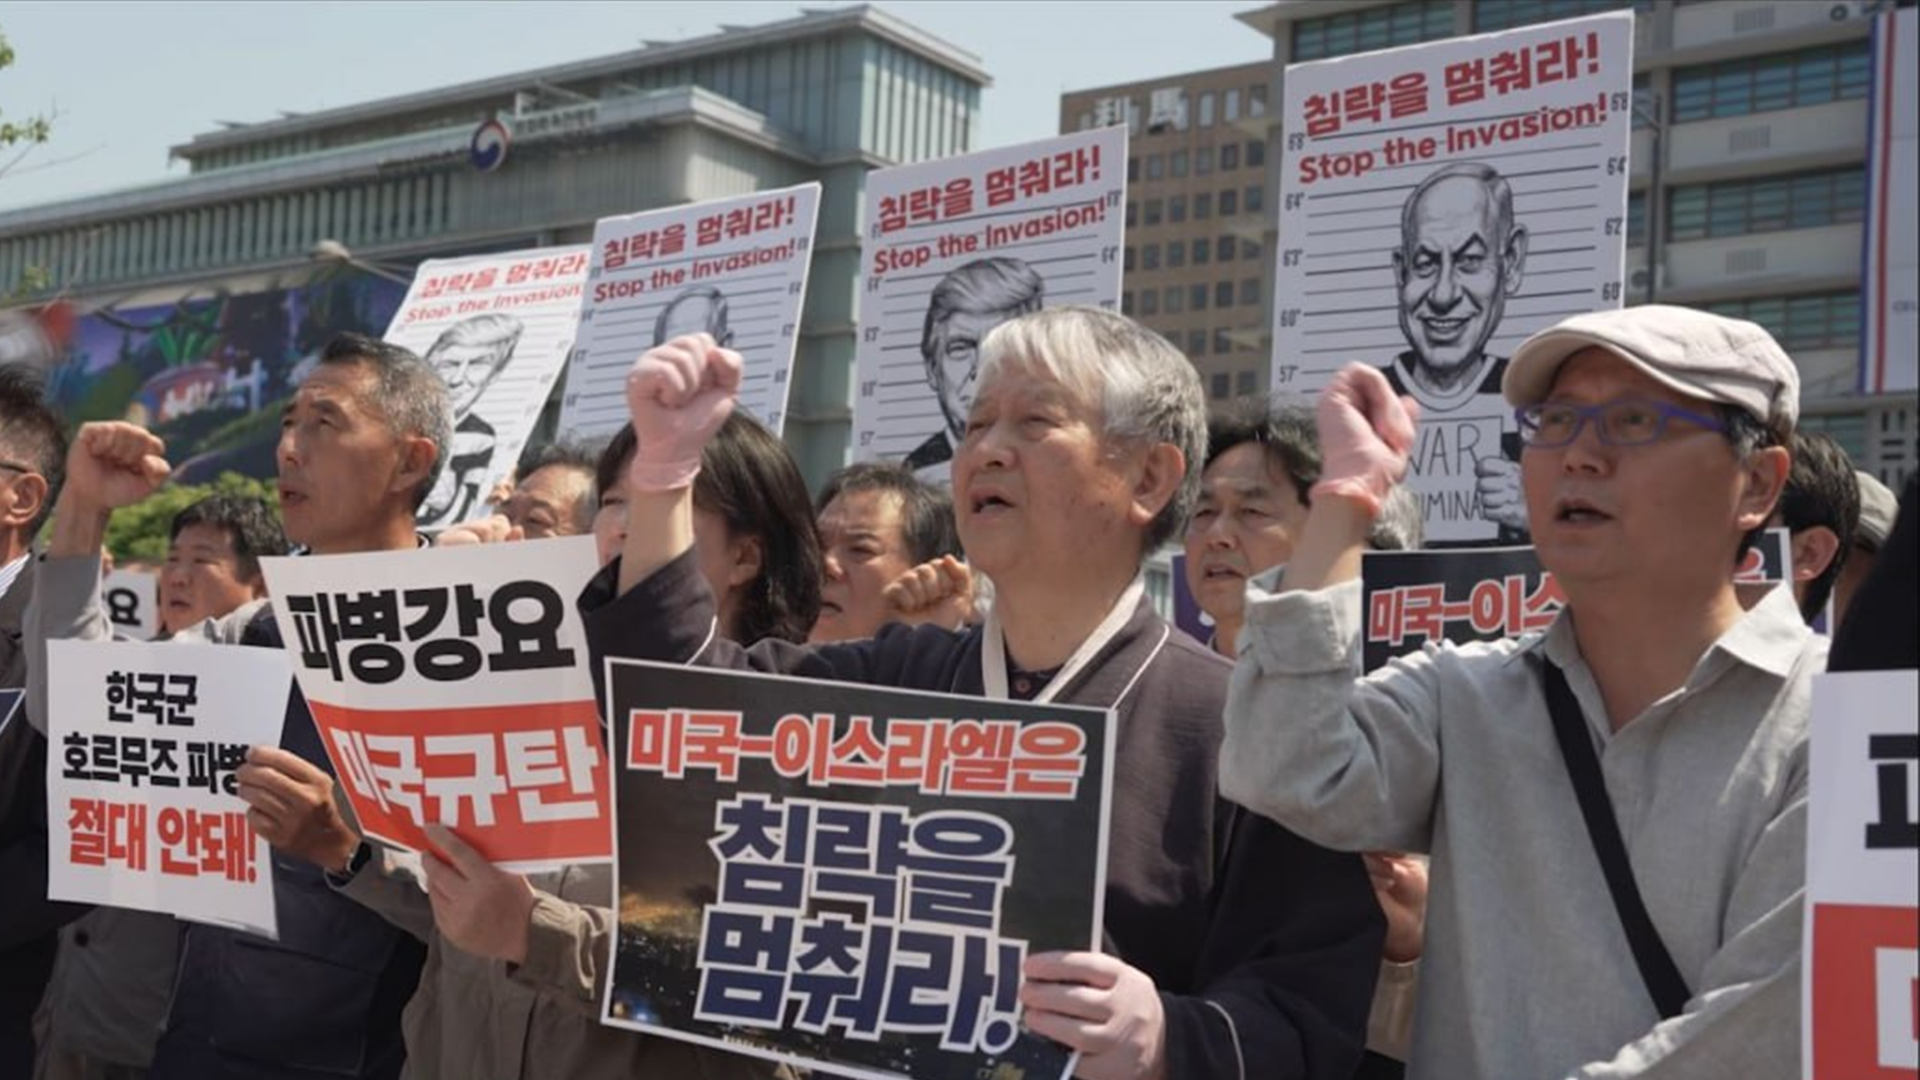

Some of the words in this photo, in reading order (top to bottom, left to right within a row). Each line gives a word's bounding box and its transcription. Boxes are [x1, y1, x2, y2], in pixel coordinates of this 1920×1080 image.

[1303, 73, 1429, 138] 침략을
[1444, 32, 1600, 105] 멈춰라!
[1299, 151, 1374, 184] Stop
[1383, 137, 1436, 166] the
[1446, 93, 1608, 153] Invasion!
[879, 178, 974, 232] 침략을
[985, 145, 1101, 207] 멈춰라!
[593, 277, 645, 303] Stop
[651, 264, 685, 288] the
[691, 238, 796, 279] Invasion!
[603, 223, 686, 271] 침략을
[696, 196, 796, 247] 멈춰라!
[874, 246, 931, 274] Stop
[938, 229, 978, 258] the
[985, 197, 1106, 249] Invasion!
[404, 306, 451, 324] Stop
[457, 299, 489, 312] the
[493, 284, 582, 308] Invasion
[421, 267, 498, 298] 침략을
[505, 253, 588, 284] 멈춰라
[107, 587, 142, 626] 요
[285, 579, 577, 685] 파병강요
[1367, 571, 1568, 646] 미국-이스
[106, 670, 198, 727] 한국군
[63, 732, 181, 788] 호르무즈
[329, 726, 600, 828] 미국규탄
[627, 708, 1087, 800] 미국-이스라엘은
[68, 797, 147, 871] 절대
[157, 806, 257, 883] 안돼!
[708, 793, 1016, 930] 침략을
[693, 904, 1028, 1054] 멈춰라!
